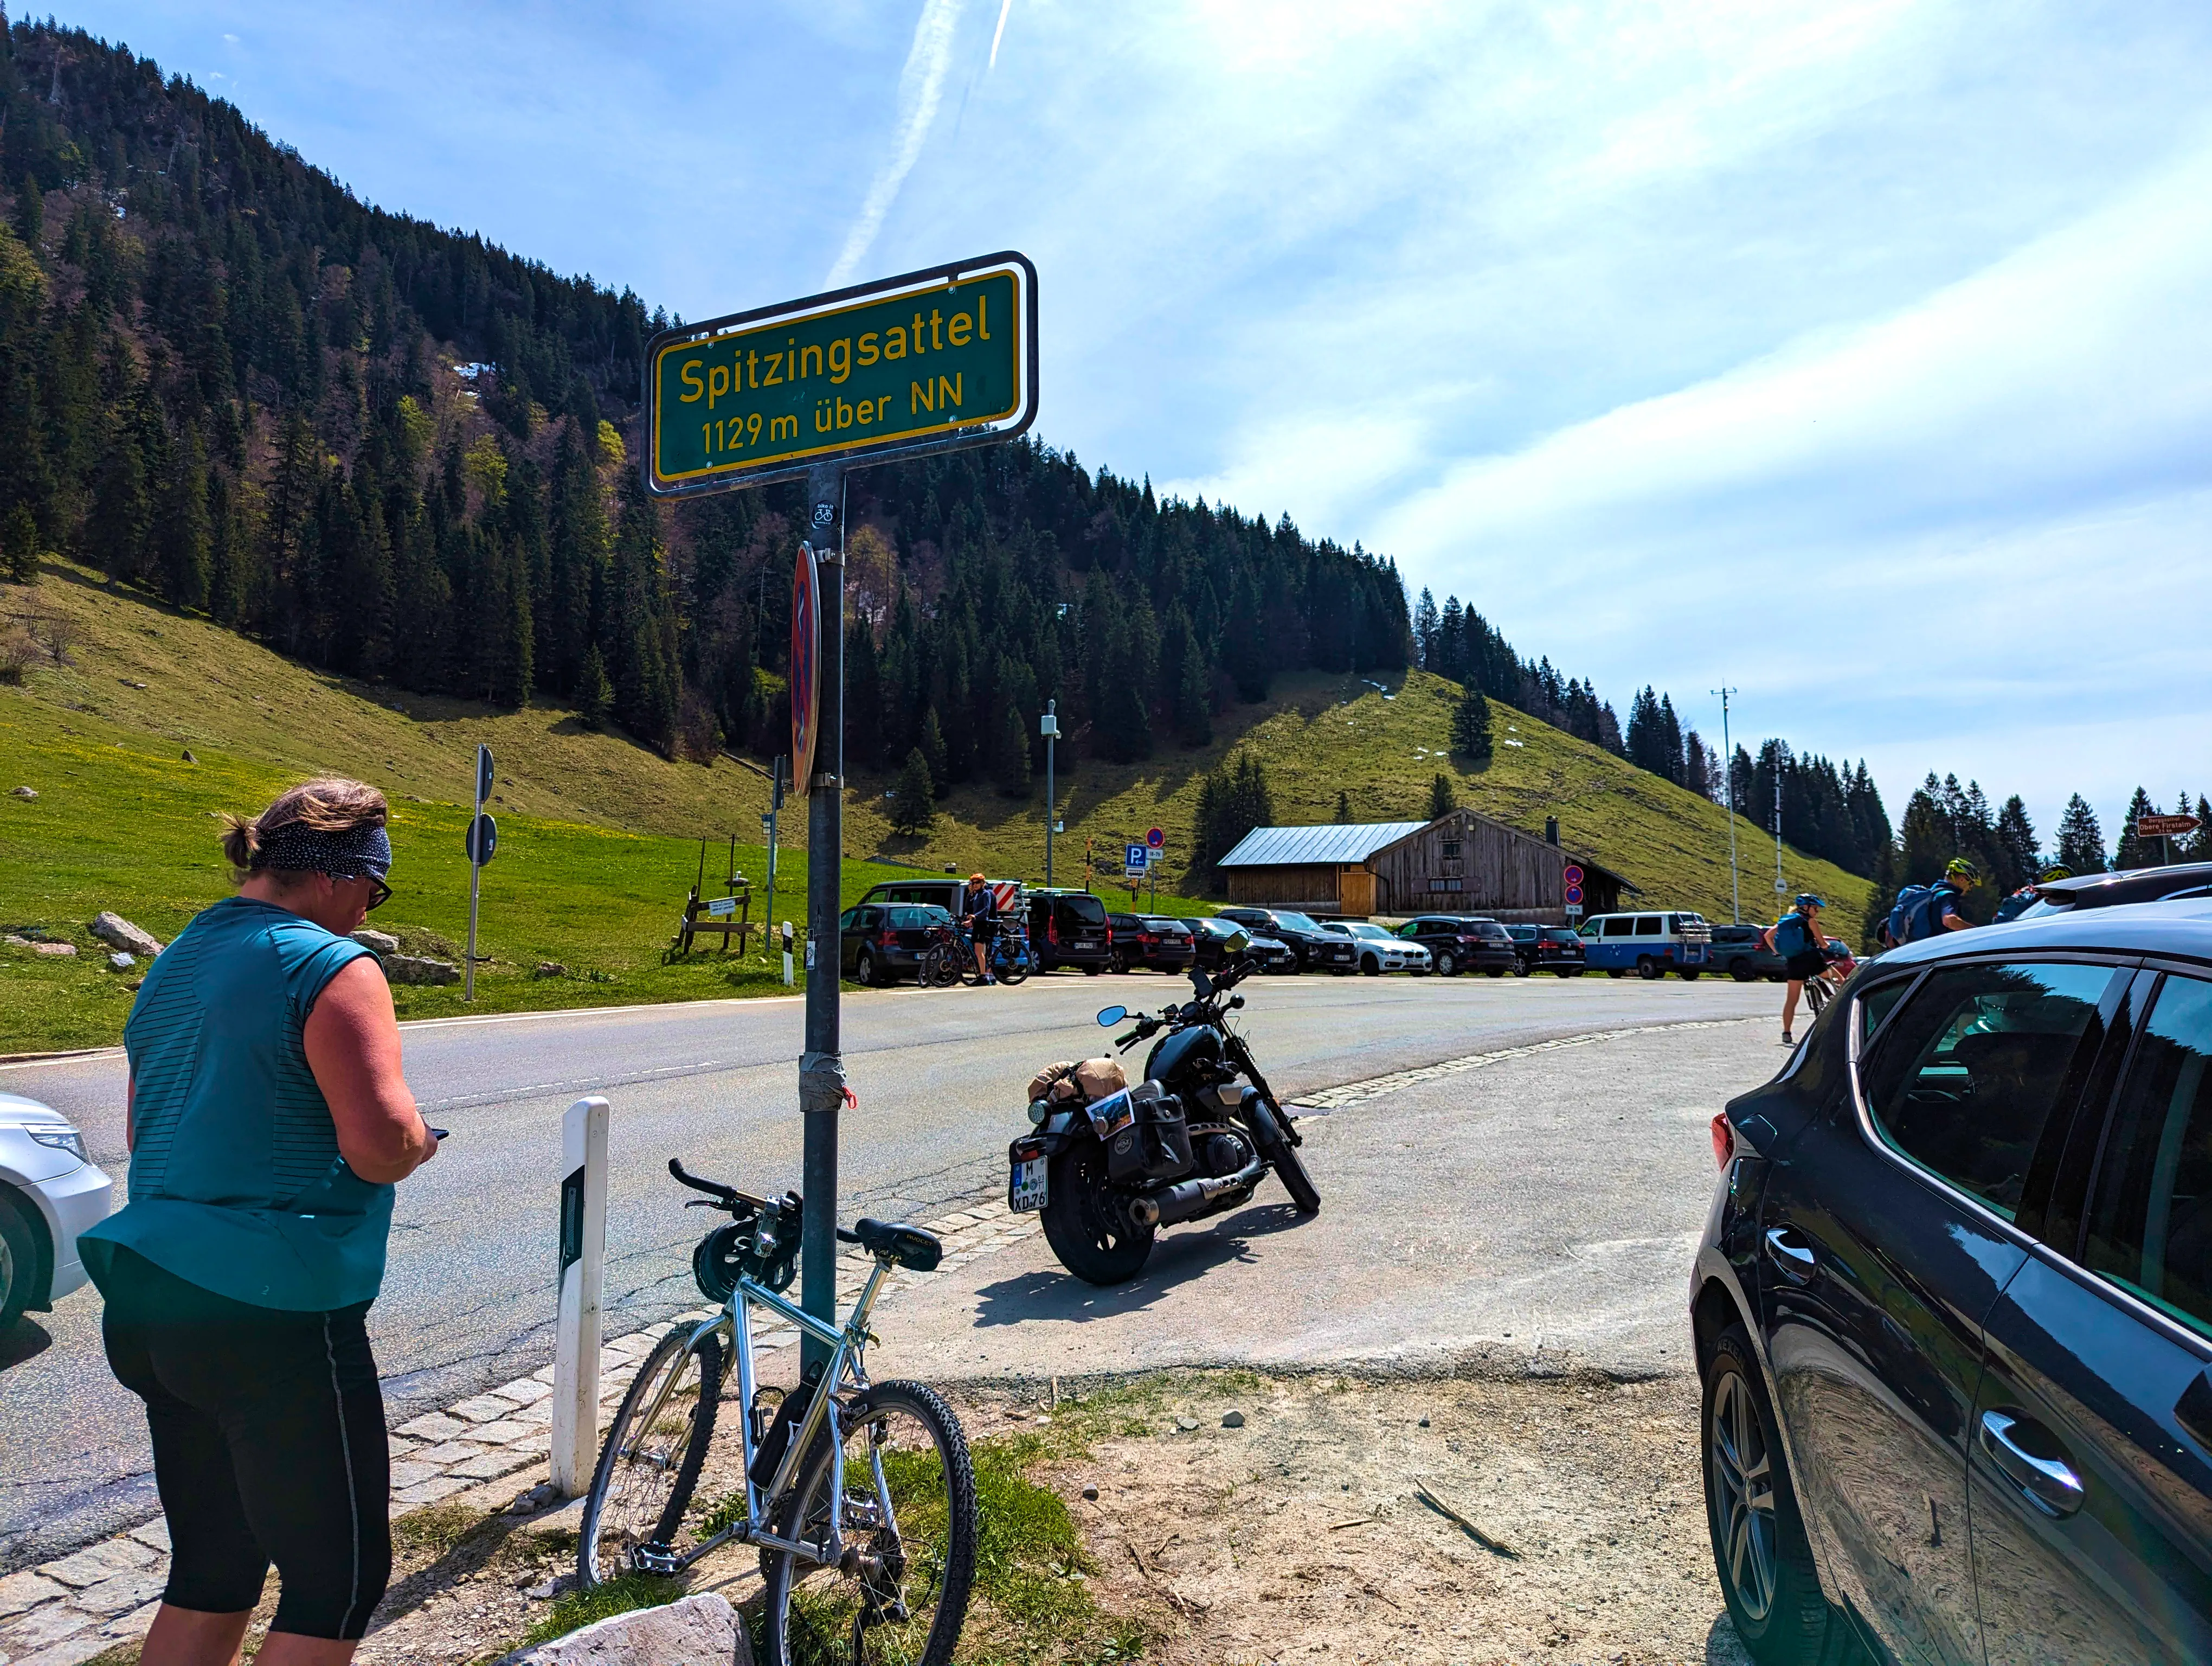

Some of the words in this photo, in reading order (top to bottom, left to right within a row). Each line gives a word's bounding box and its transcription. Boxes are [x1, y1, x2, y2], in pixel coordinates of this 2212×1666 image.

[679, 294, 991, 409] Spitzingsattel
[815, 395, 892, 433] über
[911, 372, 962, 415] NN
[1130, 848, 1142, 864] P
[1026, 1162, 1033, 1176] M
[1032, 1191, 1045, 1207] 76
[906, 1234, 933, 1246] AVOCET
